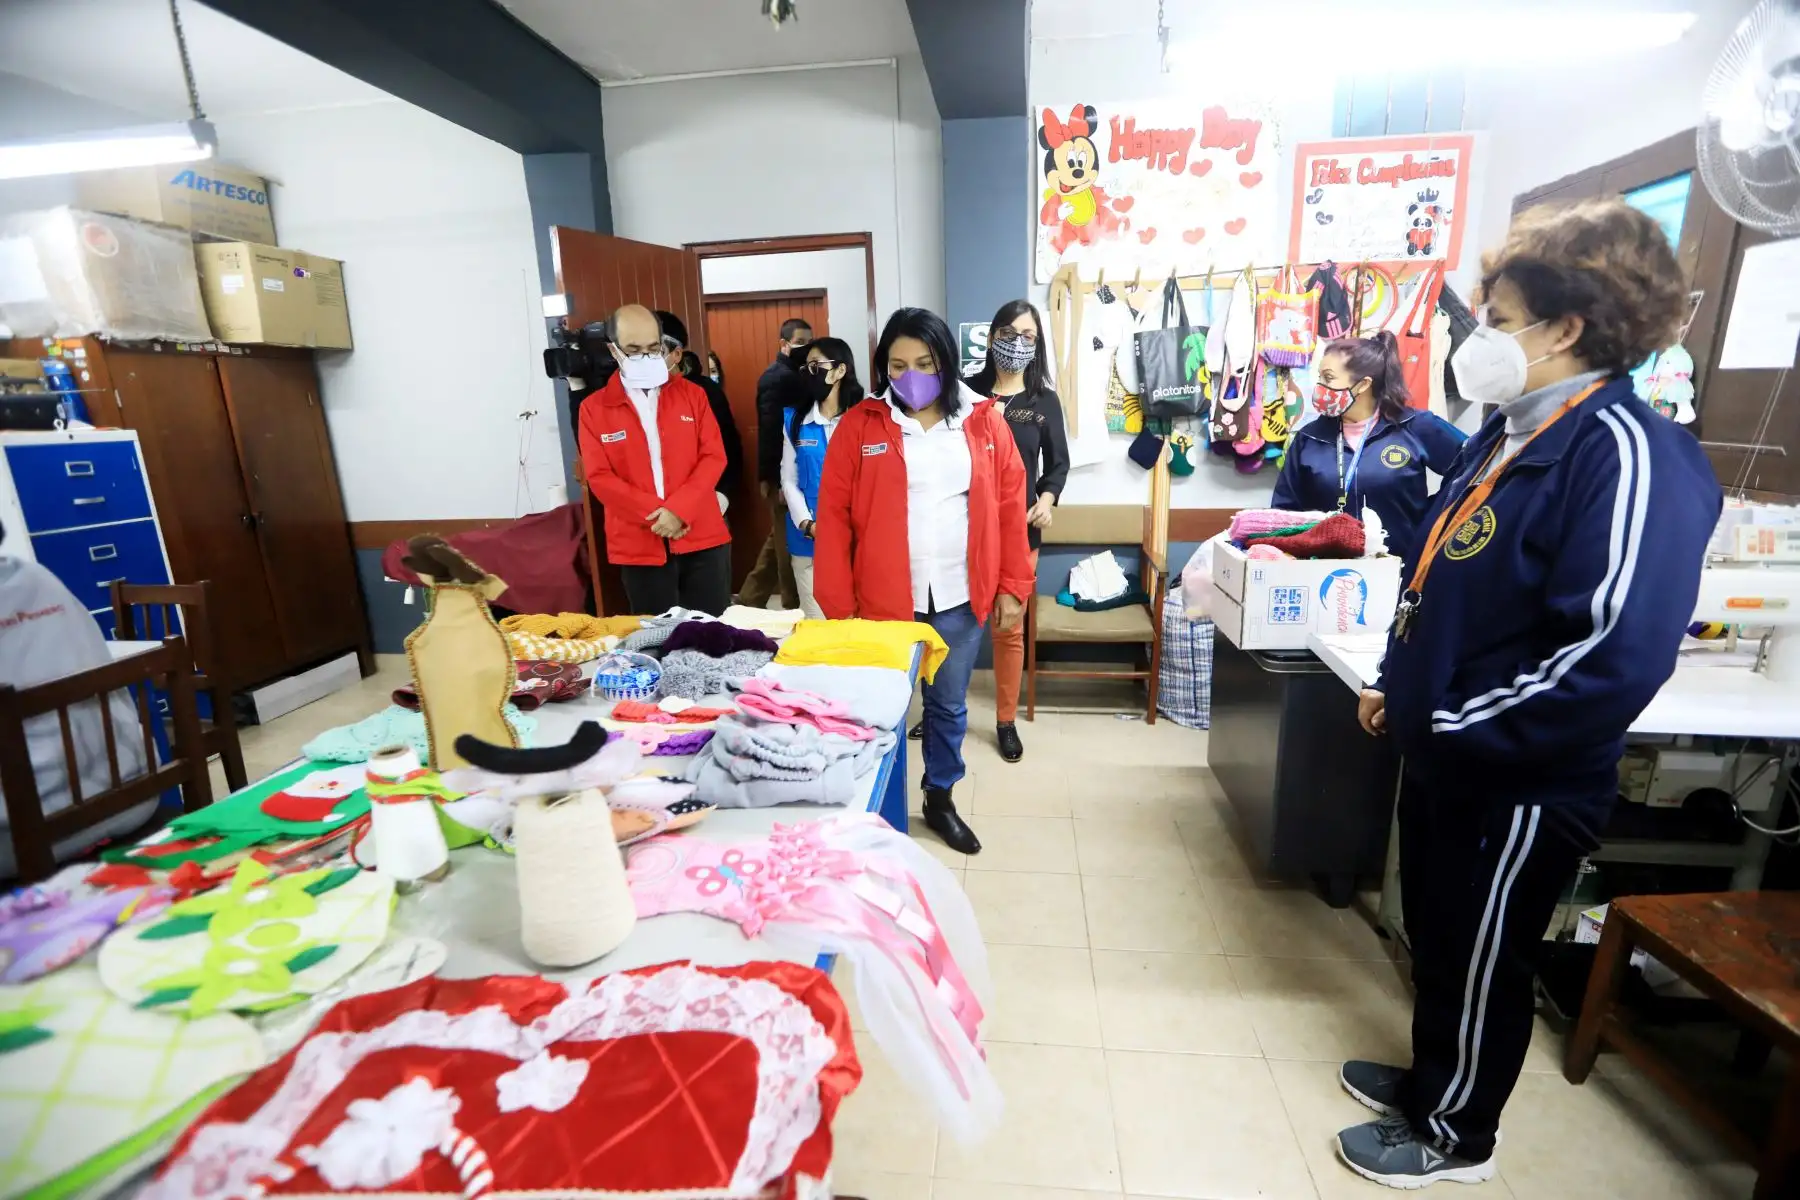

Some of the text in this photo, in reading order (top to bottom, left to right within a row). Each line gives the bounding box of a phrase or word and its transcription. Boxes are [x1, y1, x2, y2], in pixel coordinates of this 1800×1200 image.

[1109, 115, 1195, 174] Happy
[169, 170, 265, 205] ARTESCO
[1152, 384, 1201, 401] platanitos
